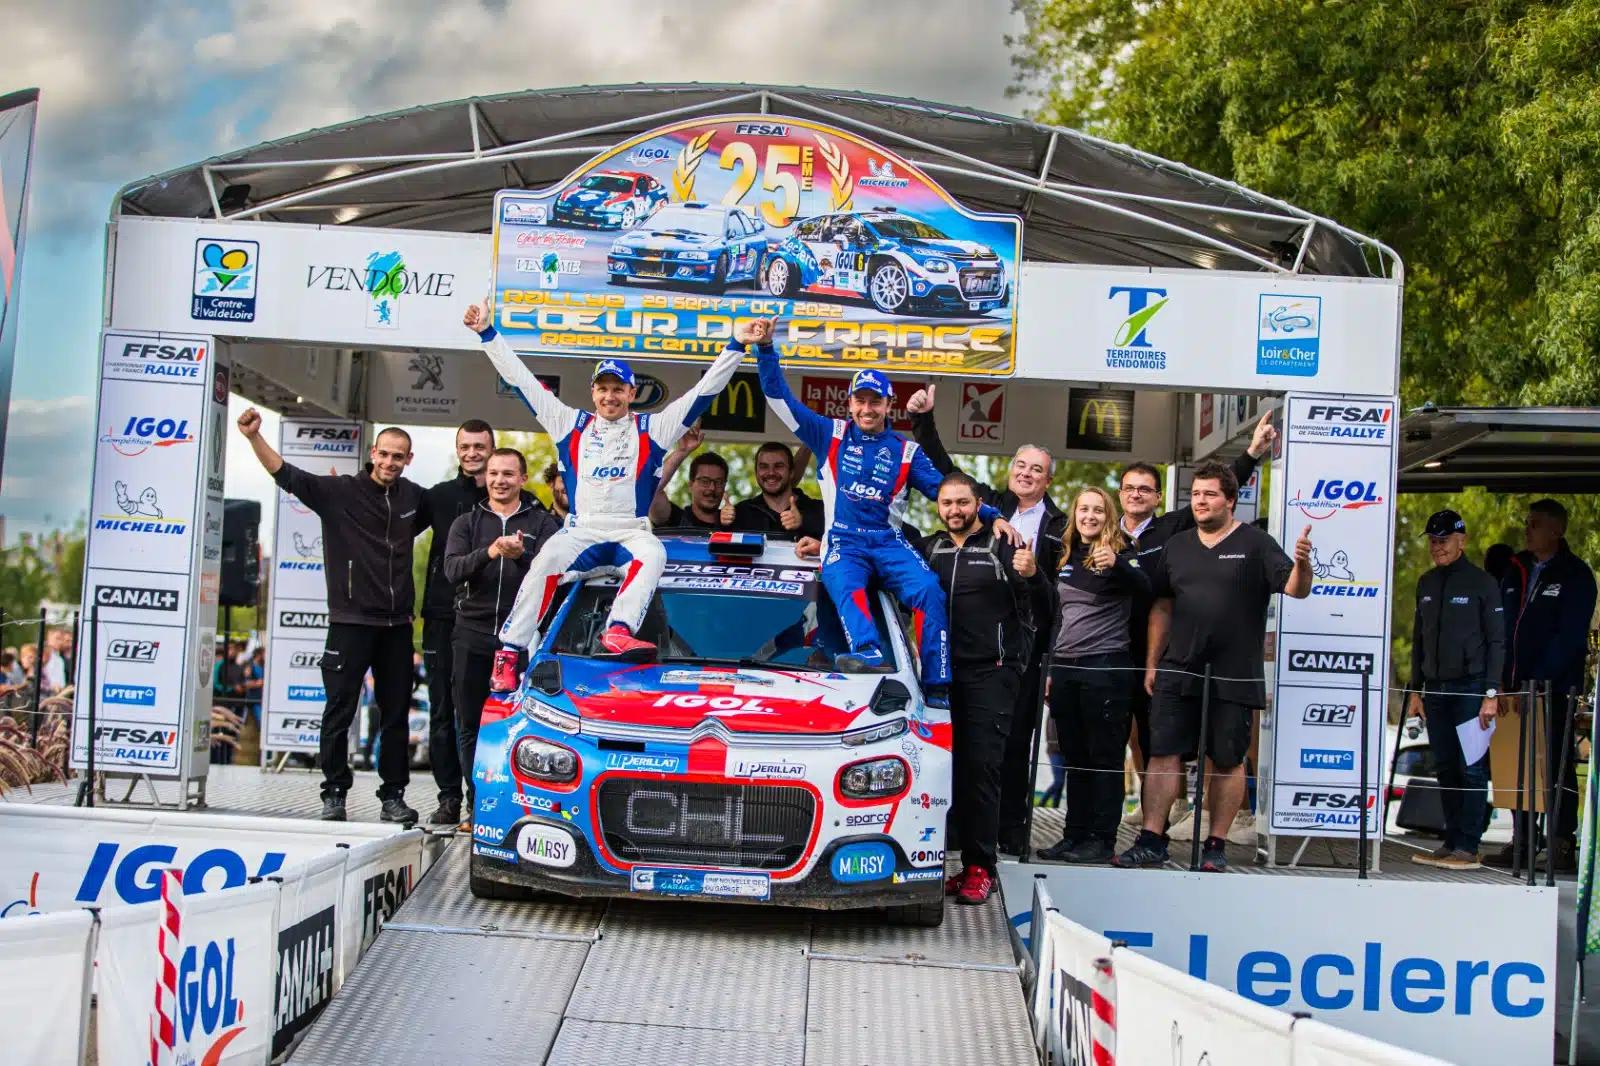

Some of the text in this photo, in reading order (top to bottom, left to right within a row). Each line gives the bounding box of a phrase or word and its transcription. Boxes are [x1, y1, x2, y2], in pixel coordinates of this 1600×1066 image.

[735, 124, 784, 136] FFSA
[639, 149, 670, 158] IGOL
[719, 141, 800, 228] 25
[858, 178, 908, 187] MICHELIN
[835, 251, 855, 269] IGOL
[306, 264, 455, 297] VENDÔME
[503, 289, 625, 308] RALLYE
[750, 300, 788, 315] OCT
[792, 301, 844, 318] 2022
[788, 319, 1006, 352] FRANCE
[122, 343, 197, 361] FFSA
[541, 333, 636, 349] REGION
[781, 344, 833, 358] VAL
[842, 347, 879, 361] DE
[887, 350, 965, 365] LOIRE
[1106, 349, 1166, 361] TERRITOIRES
[144, 364, 199, 377] RALLYE
[1106, 359, 1166, 369] VENDOMOIS
[806, 383, 821, 400] la
[396, 396, 458, 405] PEUGEOT
[1307, 406, 1381, 422] FFSA
[296, 427, 352, 440] FFSA
[960, 424, 999, 440] LDC
[1330, 426, 1386, 438] RALLYE
[313, 443, 354, 452] RALLYE
[592, 466, 626, 478] IGOL
[850, 481, 882, 499] IGOL
[1288, 498, 1341, 509] Compétition
[95, 519, 186, 535] MICHELIN
[279, 561, 324, 571] MICHE
[730, 578, 799, 591] TEAMS
[1311, 585, 1378, 598] CHELIN
[97, 588, 176, 608] CANAL+
[281, 612, 329, 627] CANAL
[290, 651, 323, 667] GT2
[1291, 652, 1371, 671] CANAL+
[282, 718, 322, 730] FFS
[94, 727, 167, 745] FFSA
[115, 748, 170, 761] RALLYE
[511, 792, 552, 809] sparco
[920, 793, 930, 809] 2
[1292, 792, 1363, 808] FFSA
[627, 790, 784, 842] CHL
[846, 813, 891, 826] sparco
[480, 847, 514, 859] MICHELIN
[526, 837, 569, 860] MARSY
[839, 855, 885, 875] MARSY
[661, 883, 695, 891] GARAGE
[273, 925, 333, 1034] ANAL+
